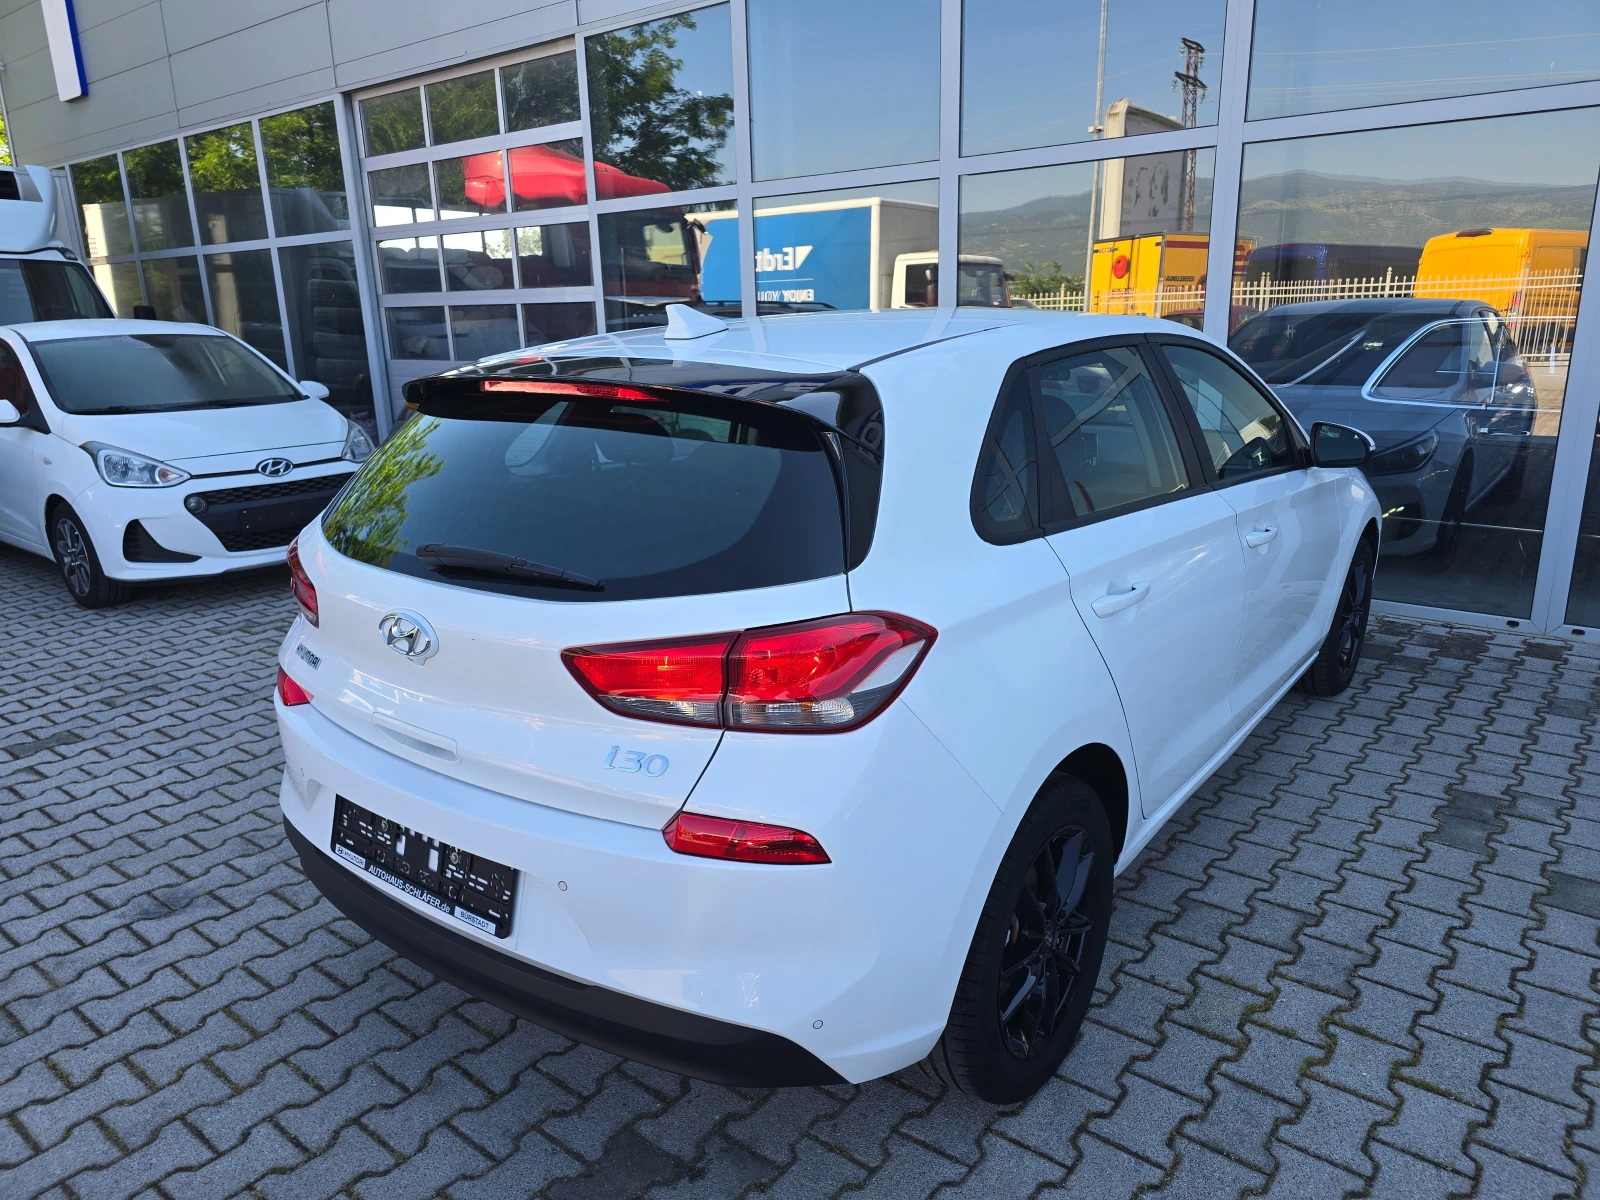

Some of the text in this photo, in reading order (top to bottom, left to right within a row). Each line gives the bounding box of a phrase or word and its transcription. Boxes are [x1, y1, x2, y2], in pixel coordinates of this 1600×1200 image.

[602, 744, 669, 778] i30
[343, 849, 365, 867] HYUNDAI
[368, 864, 451, 913] AUTOHAUS-SCHLÄFER.de
[460, 910, 489, 930] BÜRSTADT
